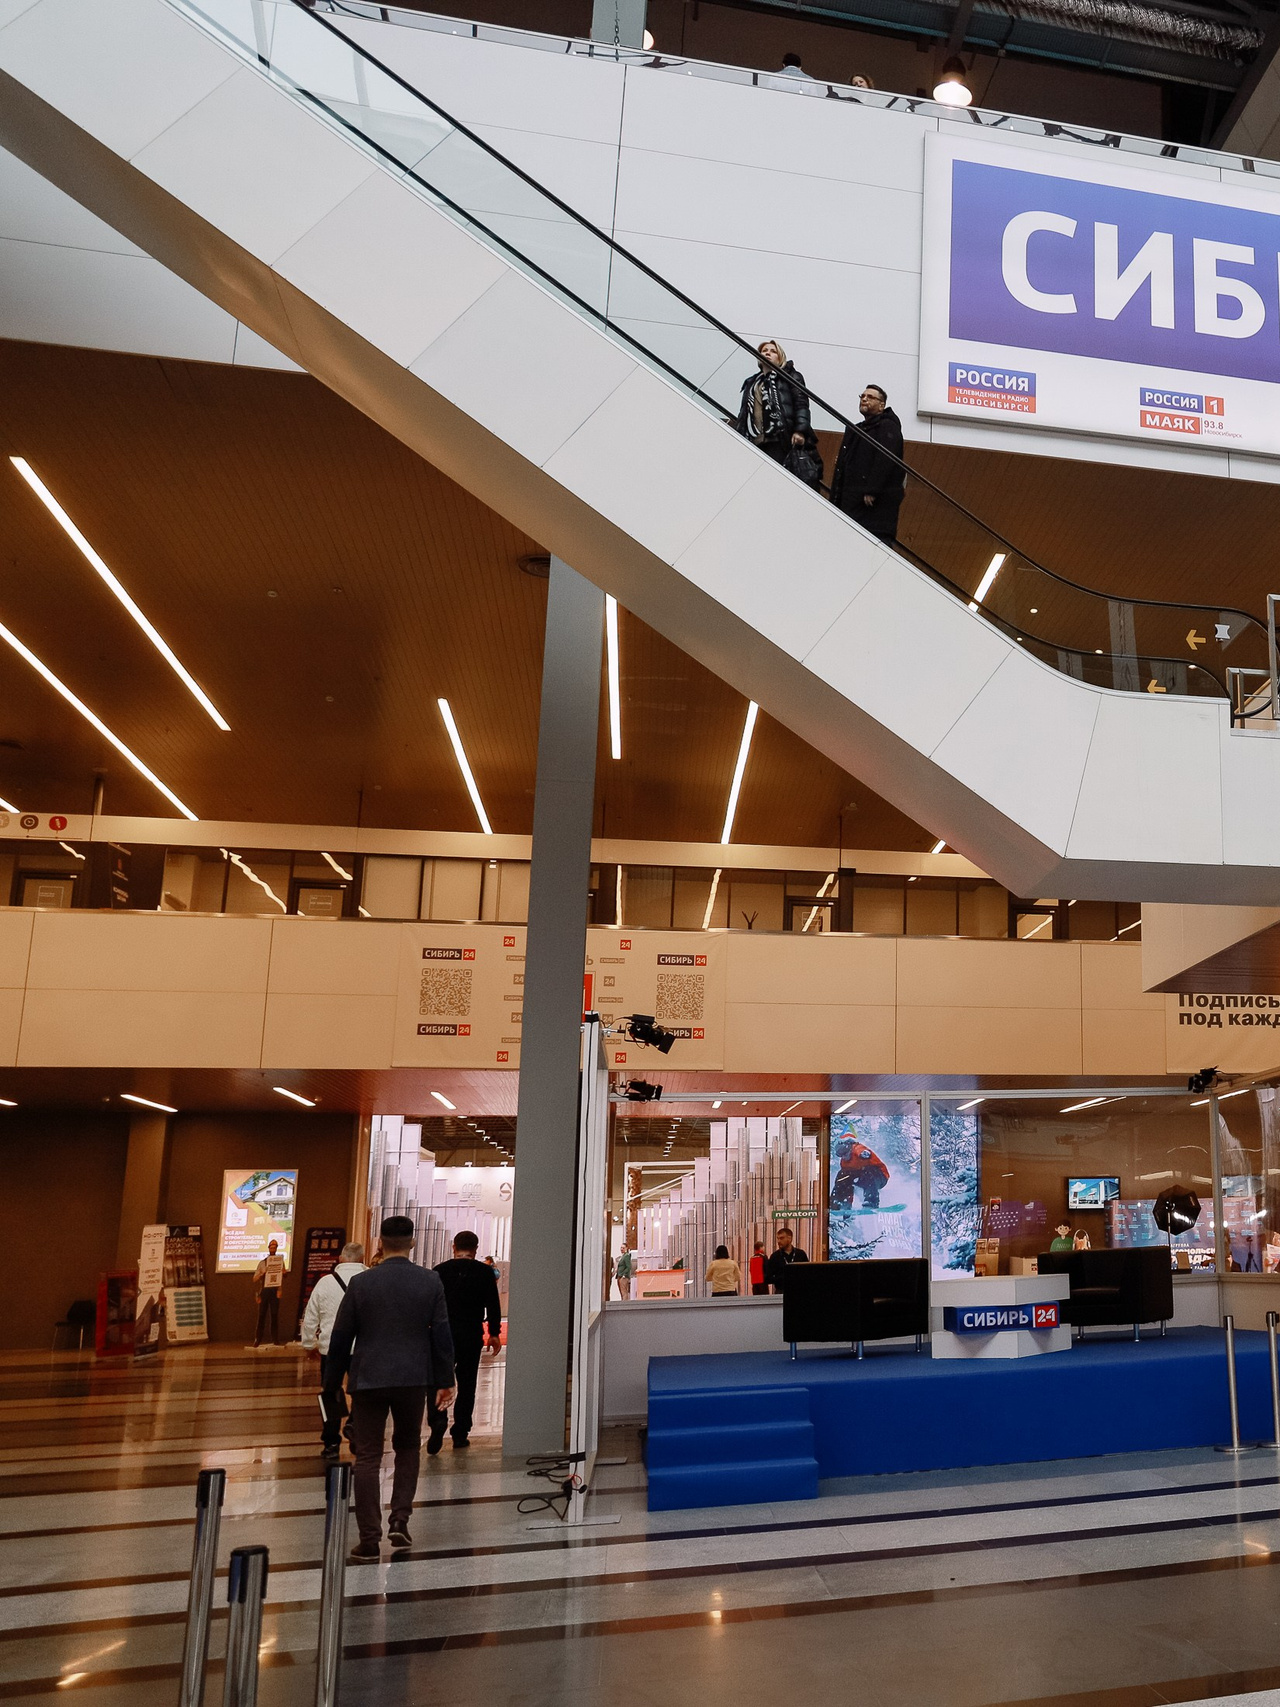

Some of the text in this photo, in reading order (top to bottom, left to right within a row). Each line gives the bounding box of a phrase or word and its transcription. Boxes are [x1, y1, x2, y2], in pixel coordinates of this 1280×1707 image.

[955, 368, 1030, 392] РОССИЯ
[955, 387, 1029, 404] ТЕЛЕВИДЕНИЕ И РАДИО
[955, 396, 1030, 412] НОВОСИБИРСК
[1145, 391, 1218, 414] РОССИЯ 1
[1145, 414, 1224, 431] МАЯК 93.8
[1204, 429, 1243, 439] Новосибирск
[621, 941, 631, 949] 24
[425, 949, 475, 959] СИБИРЬ 24
[659, 955, 693, 964] СИБИРЬ
[603, 1015, 613, 1023] 24
[1179, 1012, 1223, 1028] под
[419, 1025, 470, 1034] СИБИРЬ 24
[616, 1054, 626, 1062] 24
[963, 1308, 1056, 1328] СИБИРЬ 24
